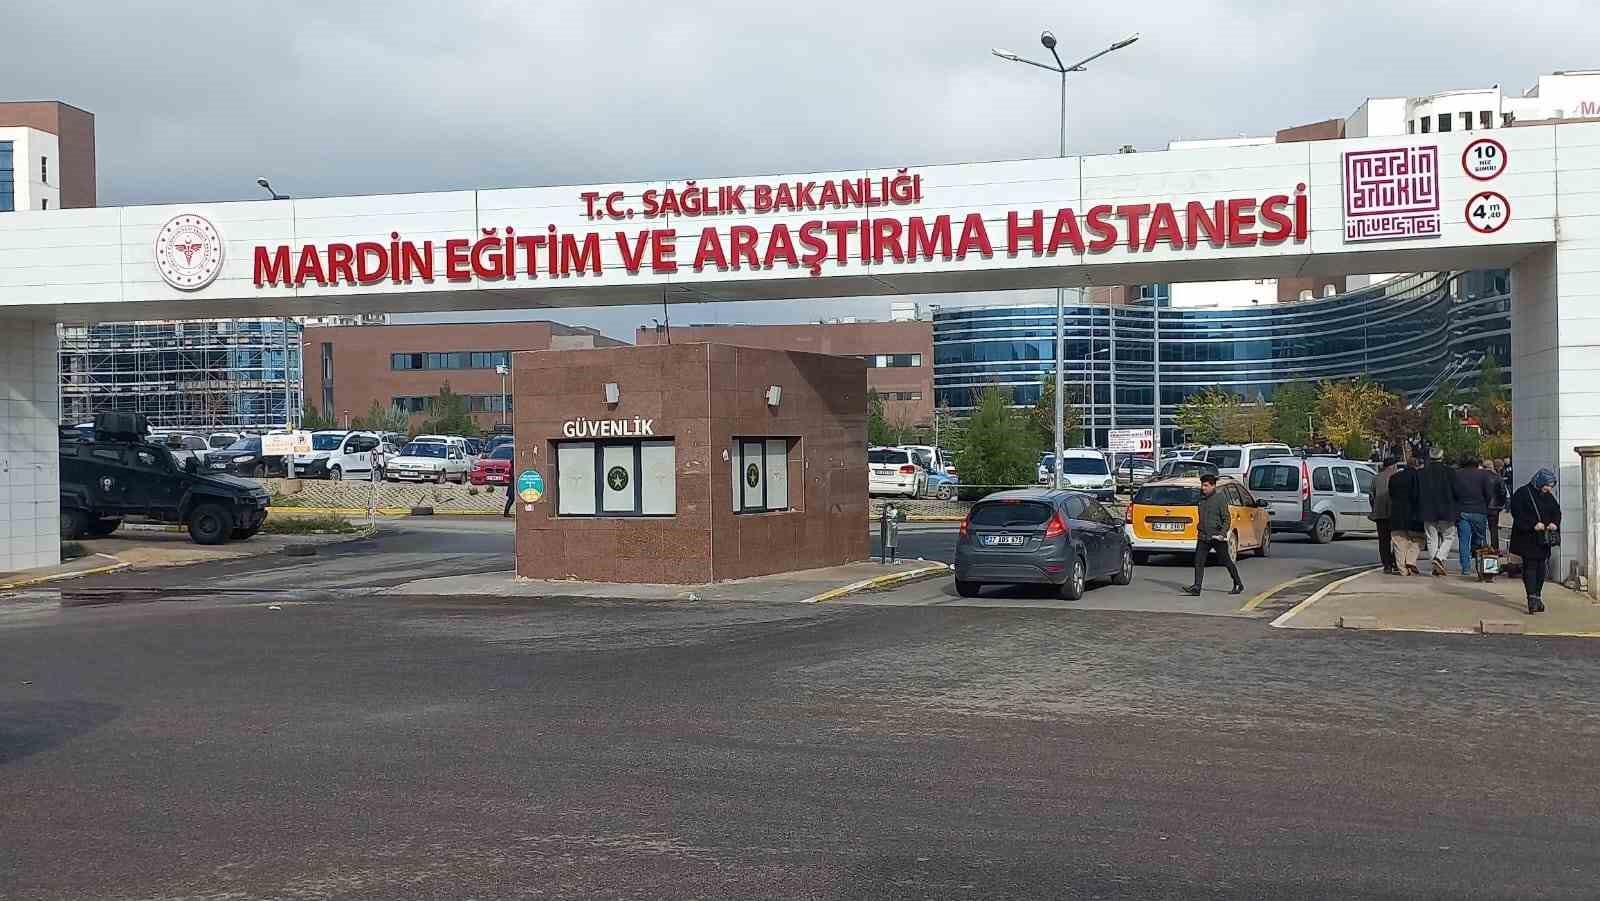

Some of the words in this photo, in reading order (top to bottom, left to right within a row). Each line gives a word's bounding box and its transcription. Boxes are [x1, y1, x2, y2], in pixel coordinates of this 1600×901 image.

[1474, 146, 1496, 158] 10
[581, 191, 633, 219] T.C.
[642, 181, 746, 217] SAĞLIK
[754, 168, 922, 214] BAKANLIĞI
[254, 231, 434, 287] MARDİN
[447, 224, 602, 282] EĞİTİM
[616, 229, 678, 275] VE
[693, 214, 993, 277] ARAŞTIRMA
[1008, 183, 1309, 259] HASTANESİ
[563, 416, 654, 437] GÜVENLİK
